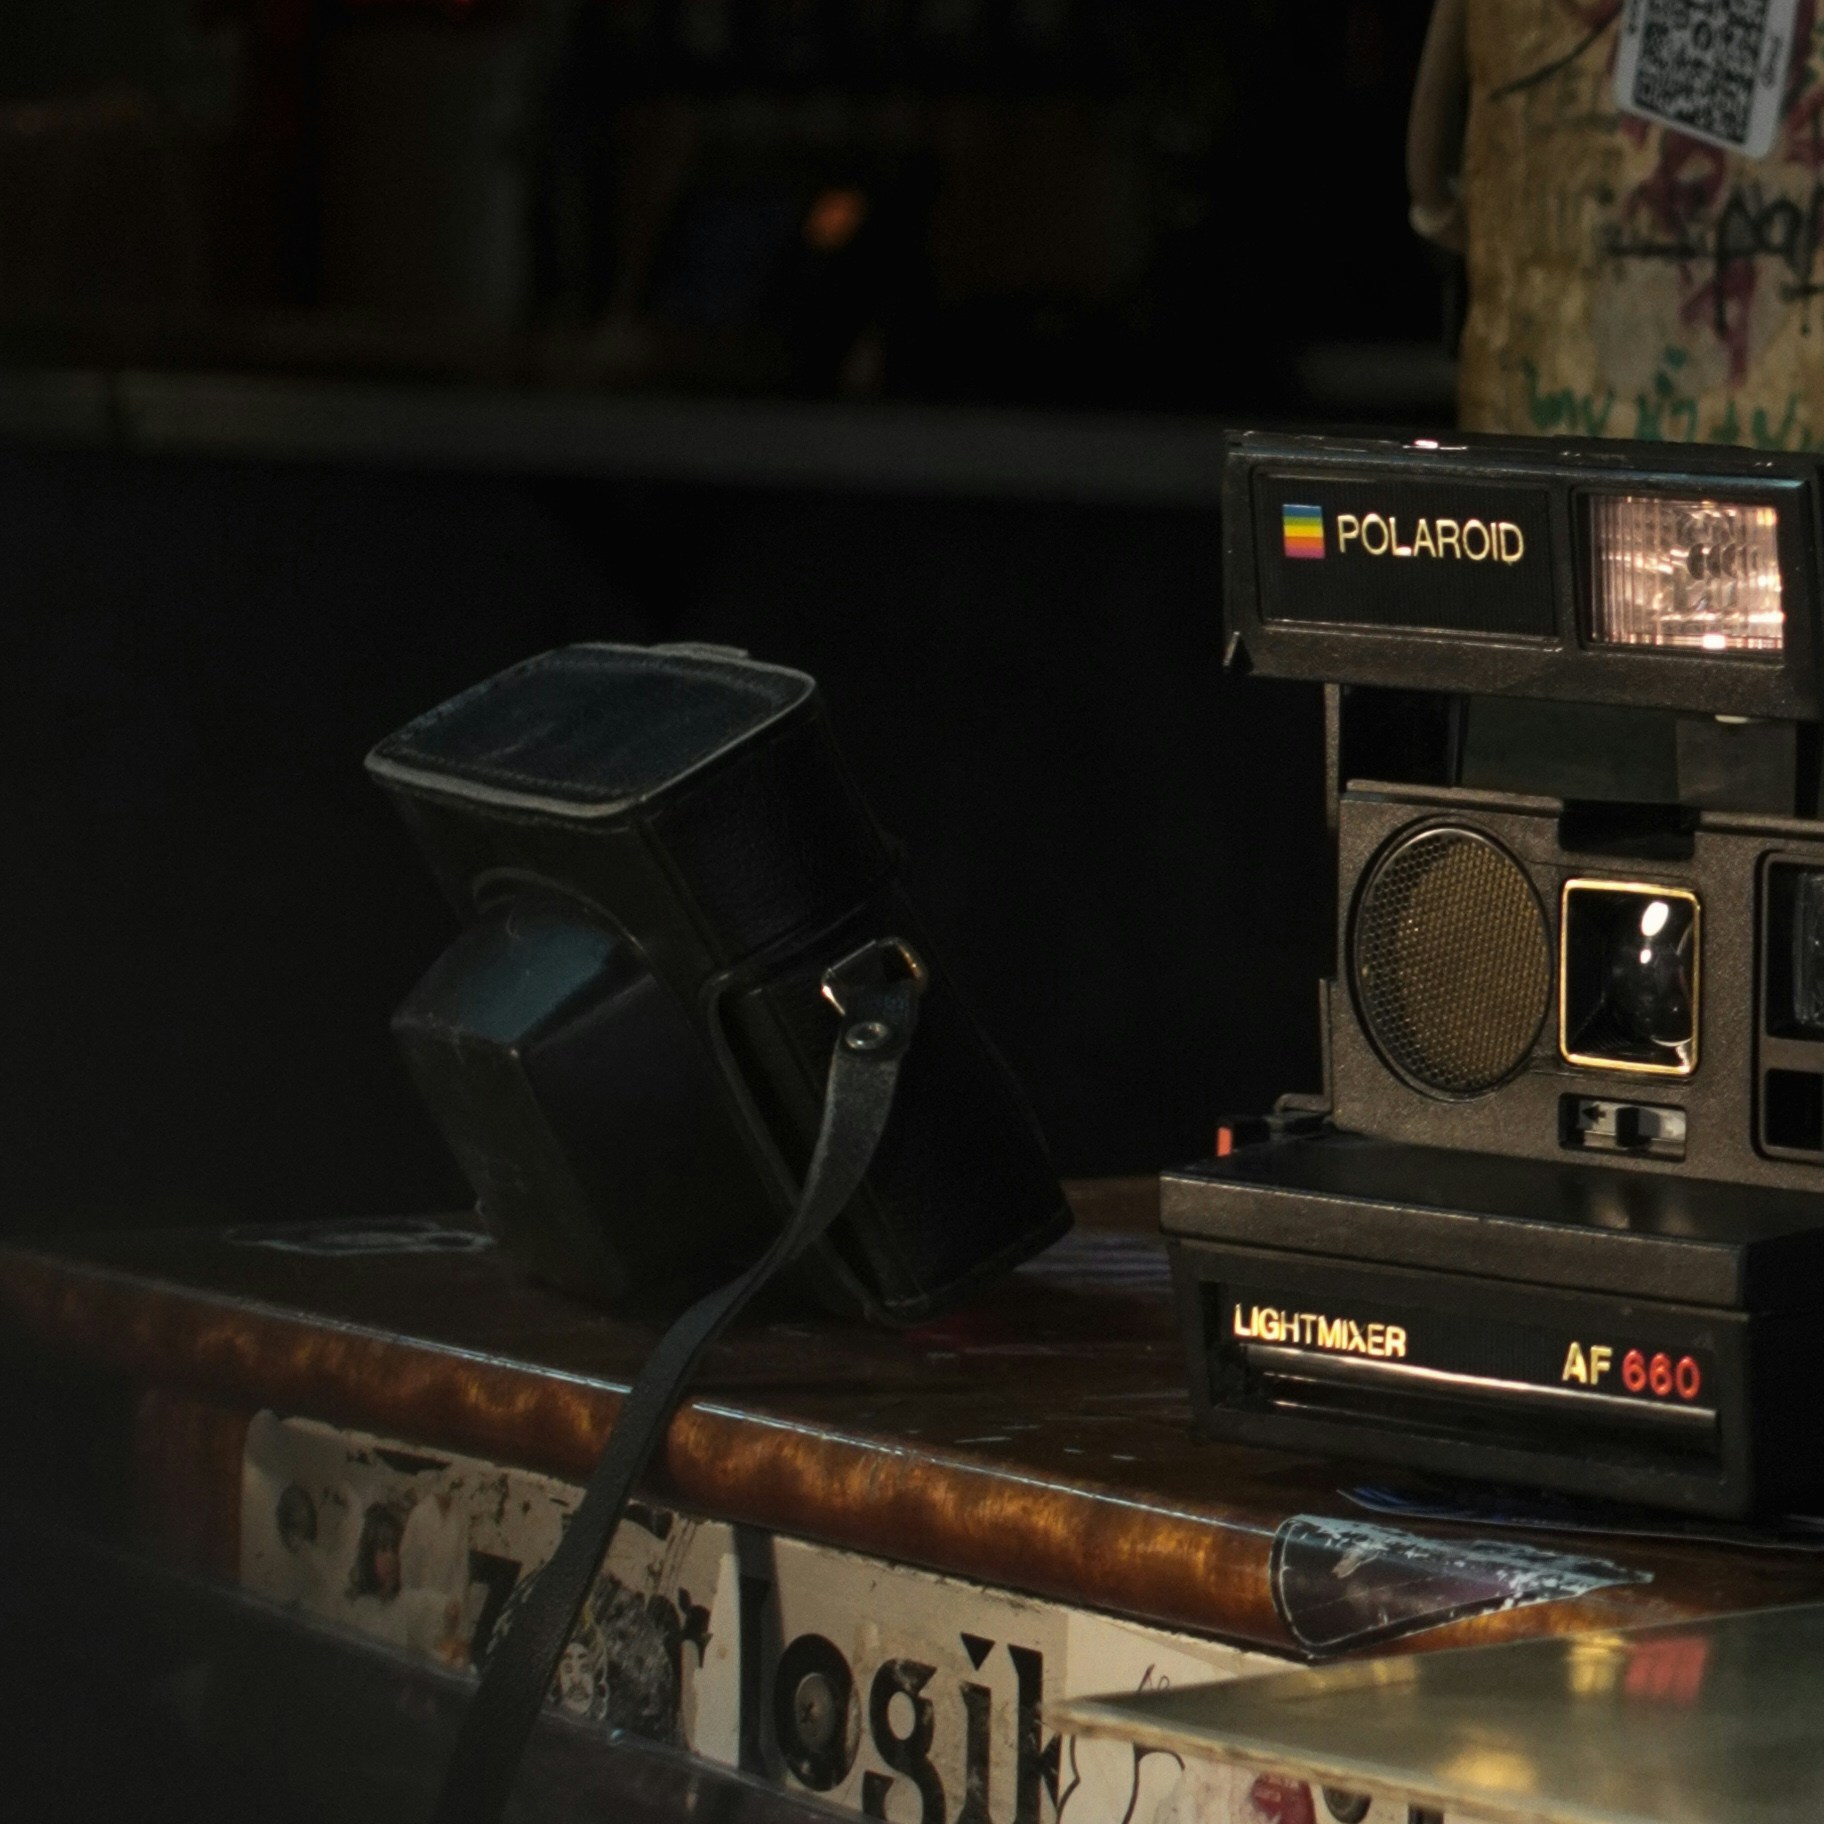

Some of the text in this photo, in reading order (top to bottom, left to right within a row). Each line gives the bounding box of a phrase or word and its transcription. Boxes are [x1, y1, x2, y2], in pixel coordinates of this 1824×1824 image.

[1337, 513, 1525, 564] POLAROID
[1234, 1302, 1701, 1401] LIGHTMIXER AF 660
